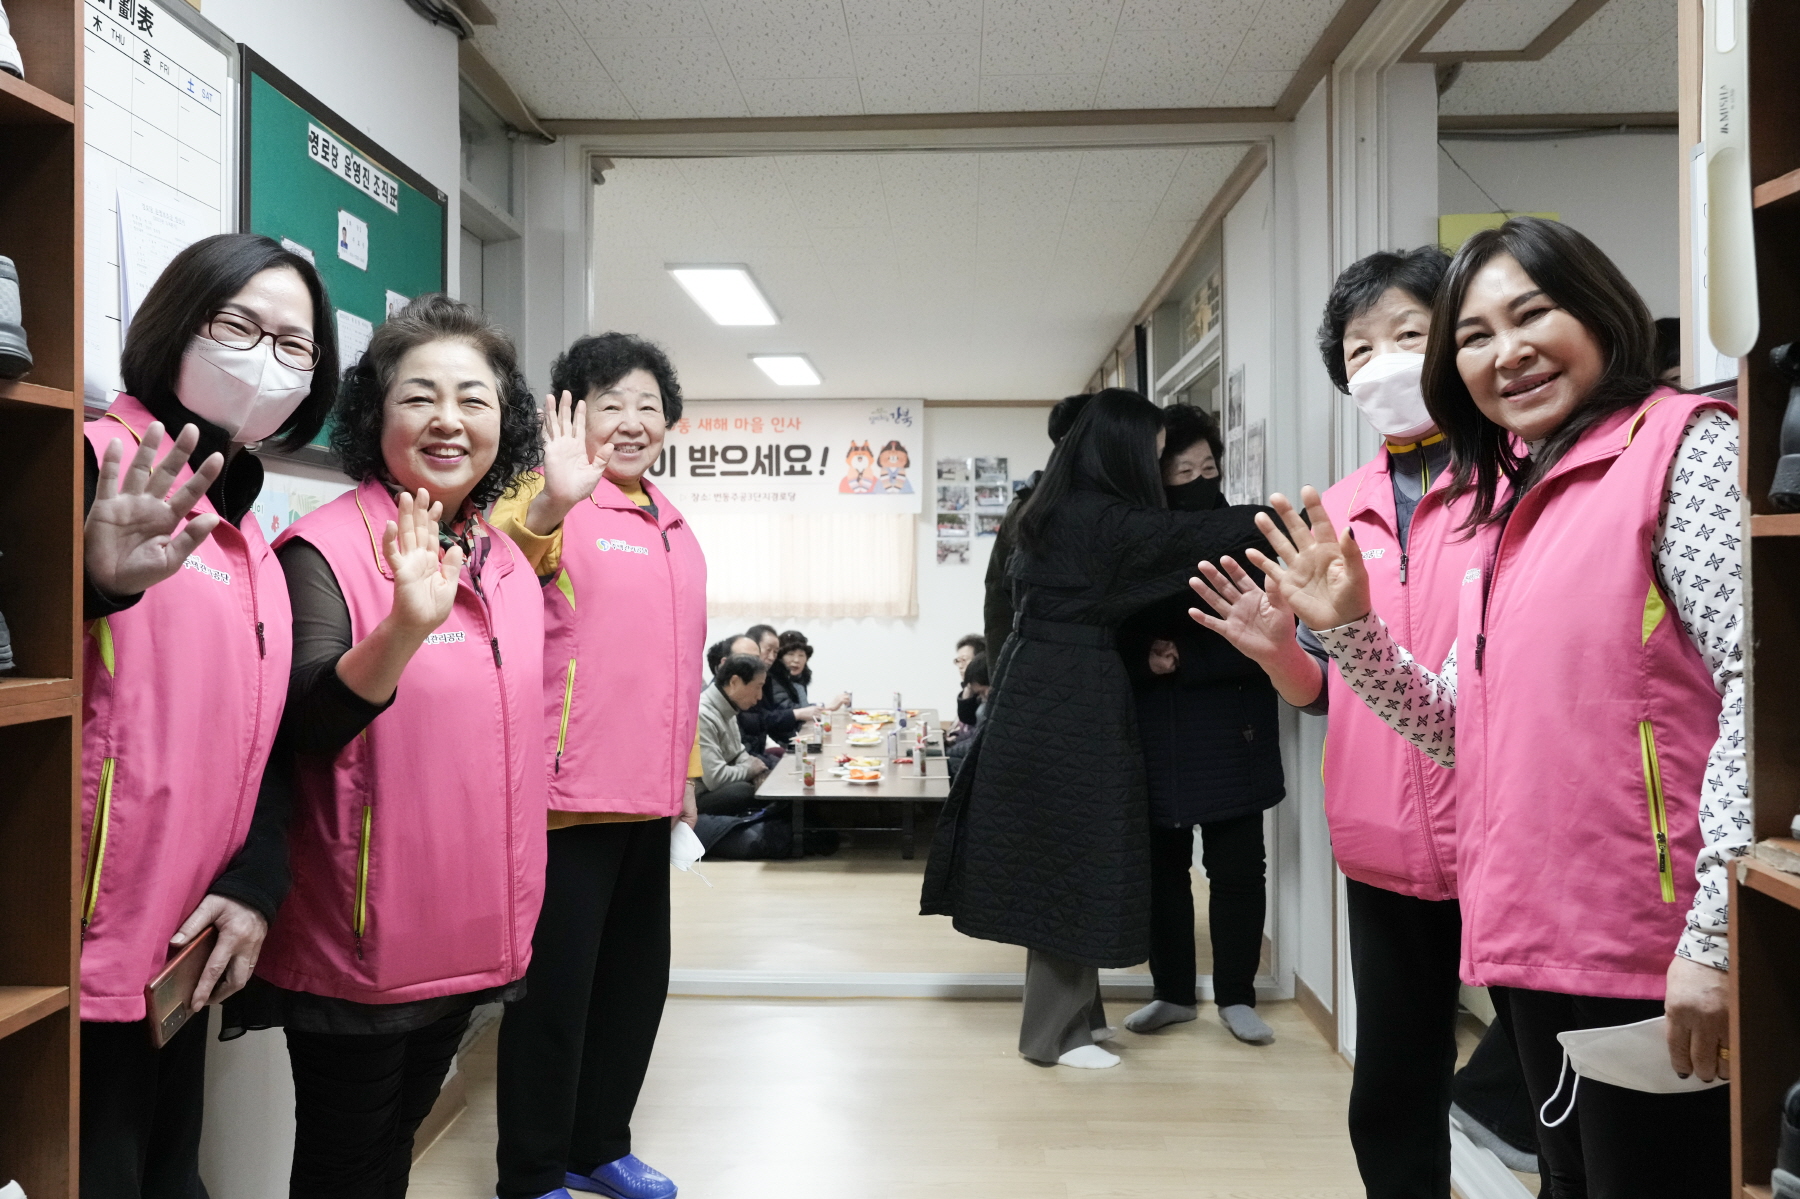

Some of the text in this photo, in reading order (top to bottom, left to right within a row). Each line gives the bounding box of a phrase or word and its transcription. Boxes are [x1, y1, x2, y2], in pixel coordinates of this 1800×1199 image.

[93, 15, 126, 46] 木 THU
[143, 48, 170, 75] 金 FRI
[187, 78, 213, 102] 土 SAT
[309, 130, 397, 207] 경로당 운영진 조직표
[670, 417, 802, 435] 동 새해 마을 인사
[688, 444, 829, 477] 받으세요!
